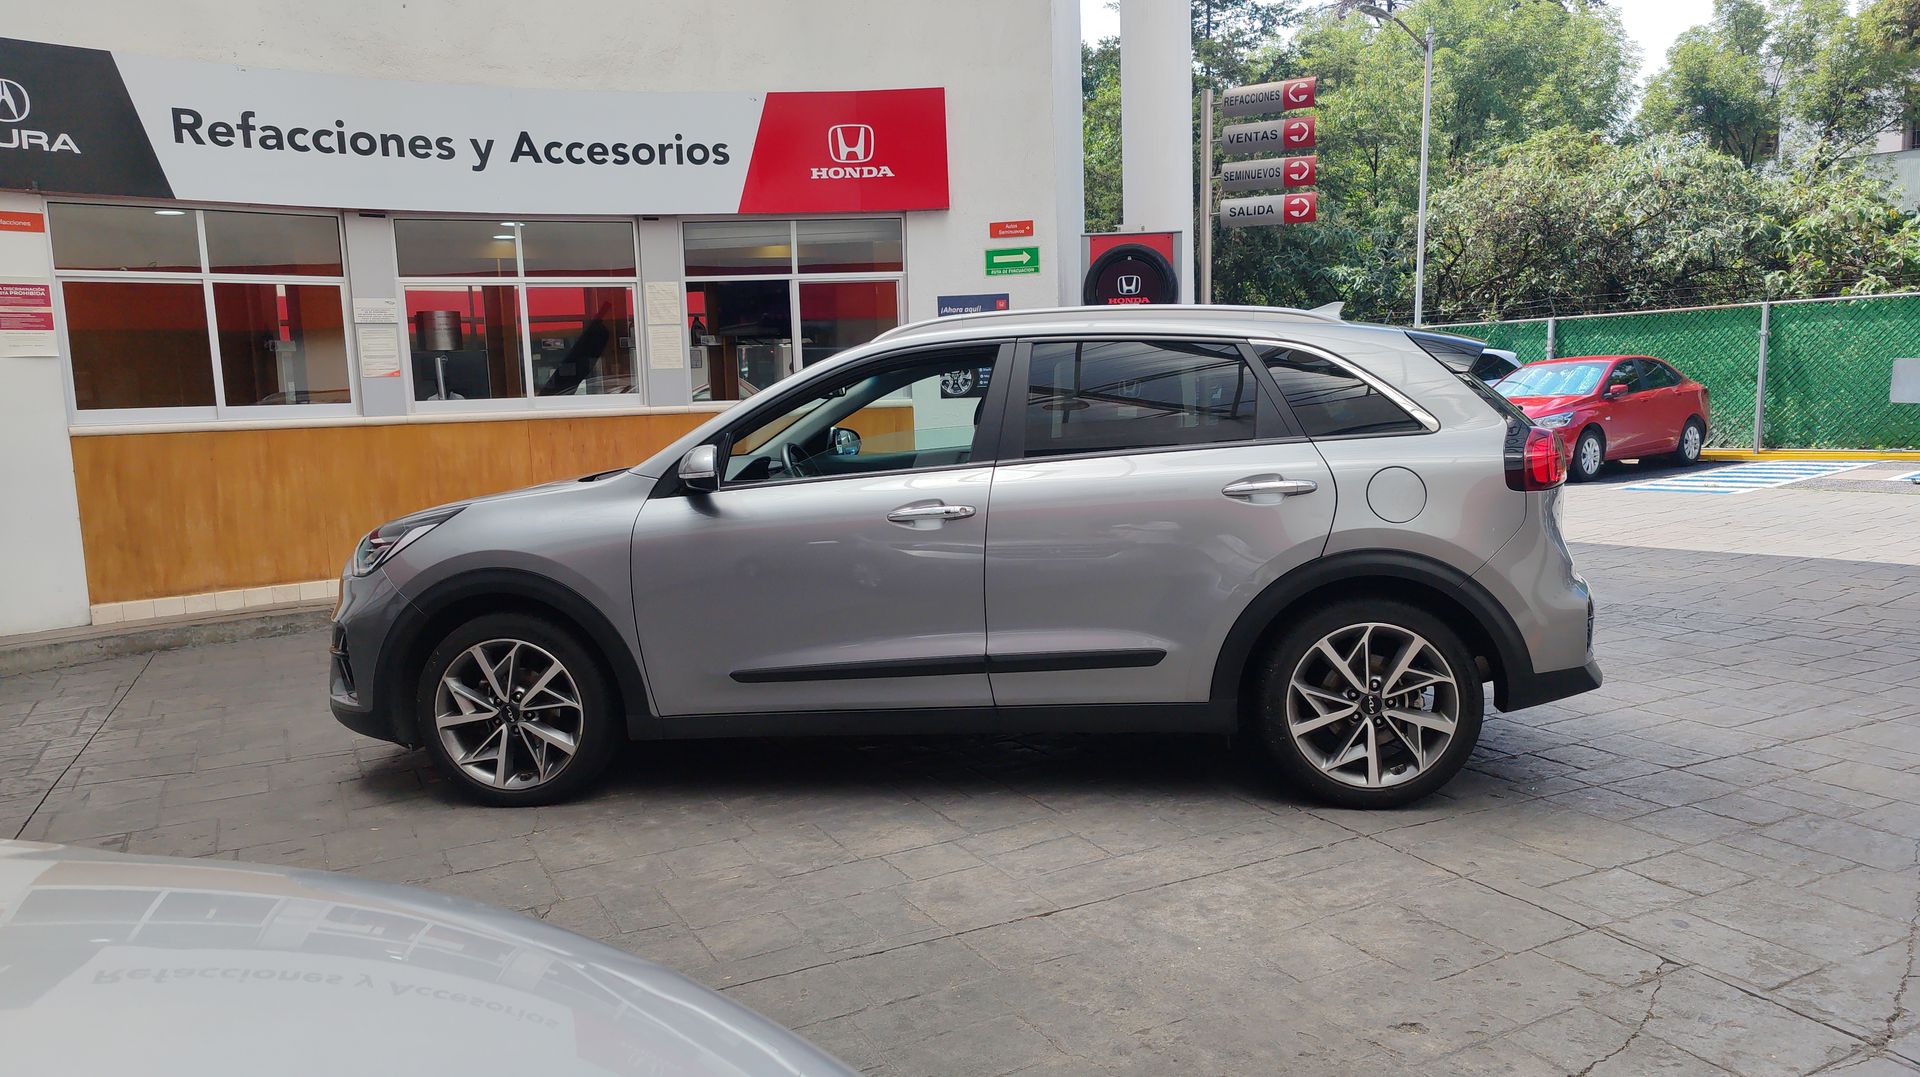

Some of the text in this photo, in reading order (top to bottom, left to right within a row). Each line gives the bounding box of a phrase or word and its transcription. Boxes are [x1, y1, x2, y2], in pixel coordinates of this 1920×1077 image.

[1224, 90, 1280, 107] REFACCIONES
[171, 107, 730, 172] Refacciones y Accesorios
[1228, 129, 1278, 144] VENTAS
[810, 165, 895, 179] HONDA
[1223, 167, 1281, 182] SEMINUEVOS
[1229, 205, 1274, 217] SALIDA
[1107, 297, 1150, 305] HONDA
